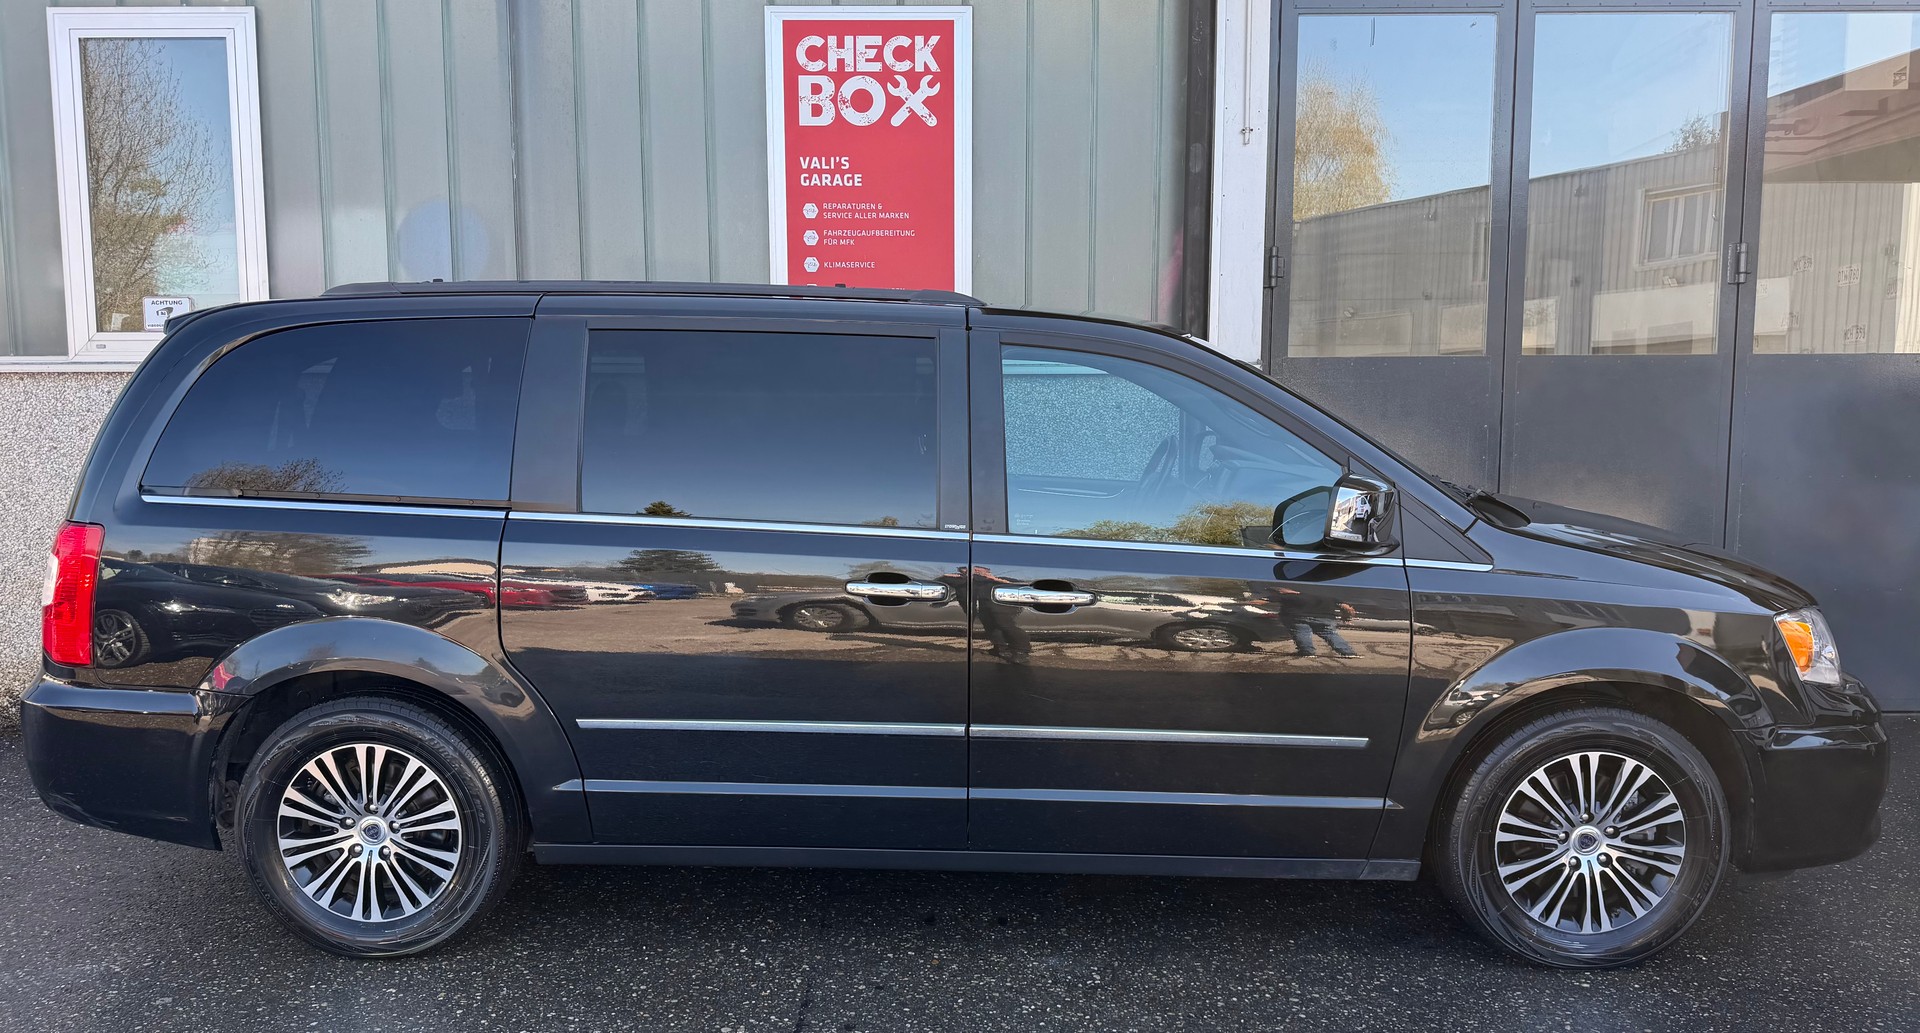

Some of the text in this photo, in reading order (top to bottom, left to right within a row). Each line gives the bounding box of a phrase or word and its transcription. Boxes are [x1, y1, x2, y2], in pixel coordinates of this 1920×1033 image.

[795, 35, 941, 72] CHECK
[797, 74, 941, 127] BOX
[799, 156, 850, 170] VALI'S
[800, 173, 863, 187] GARAGE
[822, 202, 883, 210] REPARATUREN &
[823, 229, 916, 237] FAHRZEUGAUFBEREITUNG
[823, 238, 838, 246] FÜR
[823, 261, 876, 269] KLIMASERVICE
